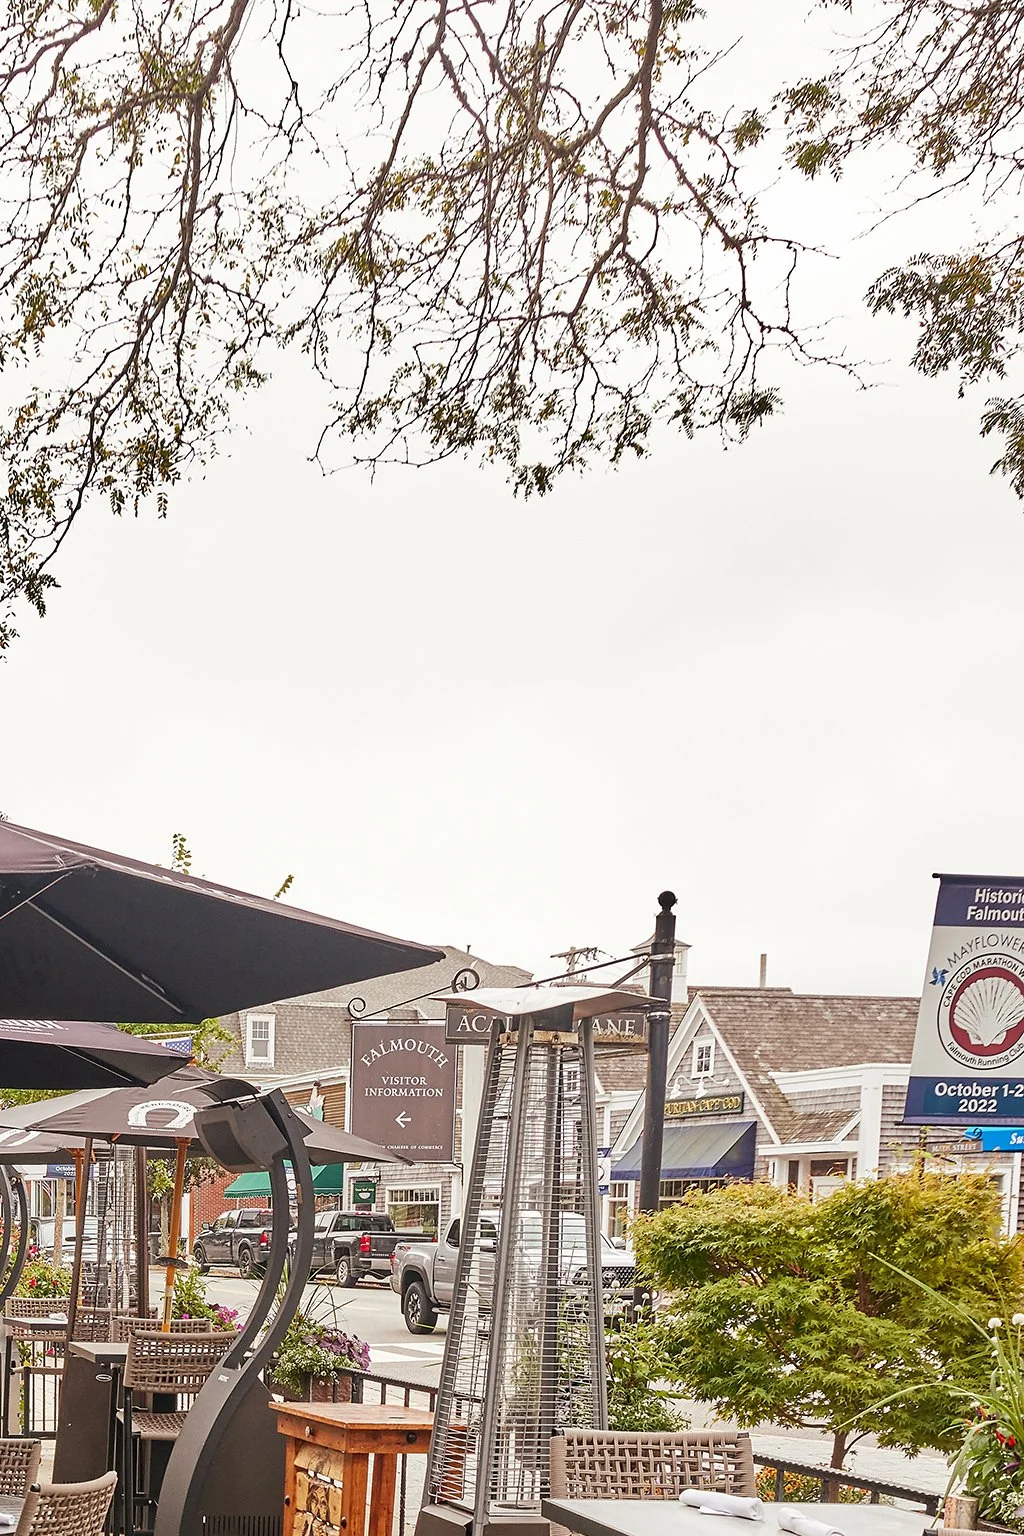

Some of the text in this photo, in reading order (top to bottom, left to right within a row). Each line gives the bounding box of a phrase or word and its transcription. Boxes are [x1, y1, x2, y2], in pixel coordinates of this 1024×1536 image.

[966, 905, 1024, 921] Falmout
[943, 956, 1019, 1008] CAPE COD MARATHON
[572, 1018, 636, 1037] ANE
[361, 1038, 449, 1069] FALMOUTH
[946, 1041, 977, 1065] Falmouth
[977, 1055, 1010, 1067] Running
[382, 1076, 427, 1085] VISITOR
[364, 1087, 444, 1097] INFORMATION
[934, 1082, 999, 1097] October
[957, 1099, 998, 1113] 2022
